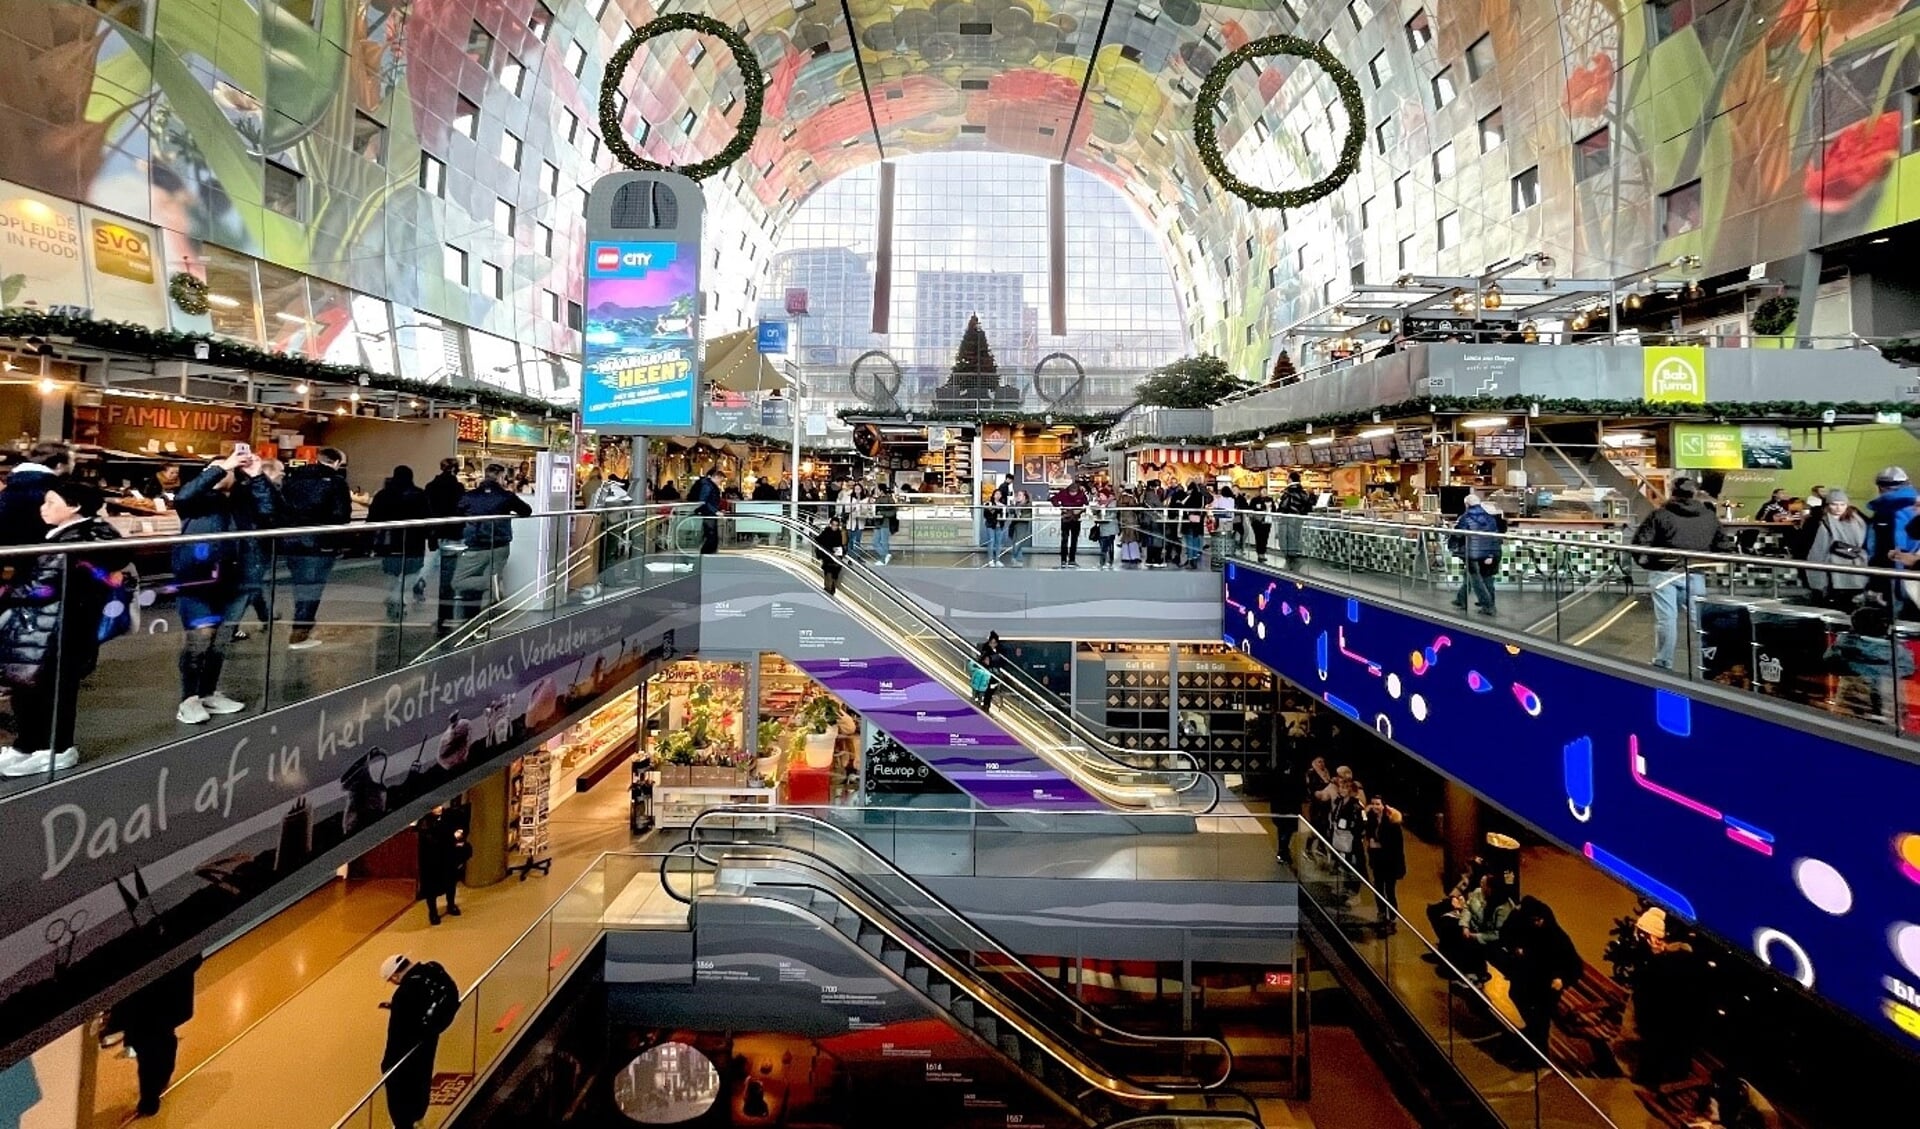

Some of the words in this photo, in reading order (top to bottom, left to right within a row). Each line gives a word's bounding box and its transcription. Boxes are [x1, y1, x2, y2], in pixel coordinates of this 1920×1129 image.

[0, 214, 78, 246] OPLEIDER
[55, 214, 76, 231] DE
[8, 231, 24, 247] IN
[29, 237, 78, 261] FOOD!
[95, 228, 141, 253] SVO
[623, 252, 652, 266] CITY
[618, 360, 688, 389] HEEN?
[107, 404, 191, 429] FAMILY
[193, 411, 243, 433] NUTS
[41, 767, 169, 881] Daal
[195, 737, 249, 818] af
[268, 725, 300, 782] in
[318, 697, 371, 761] het
[384, 655, 514, 732] Rotterdams
[873, 764, 915, 778] Fleurop
